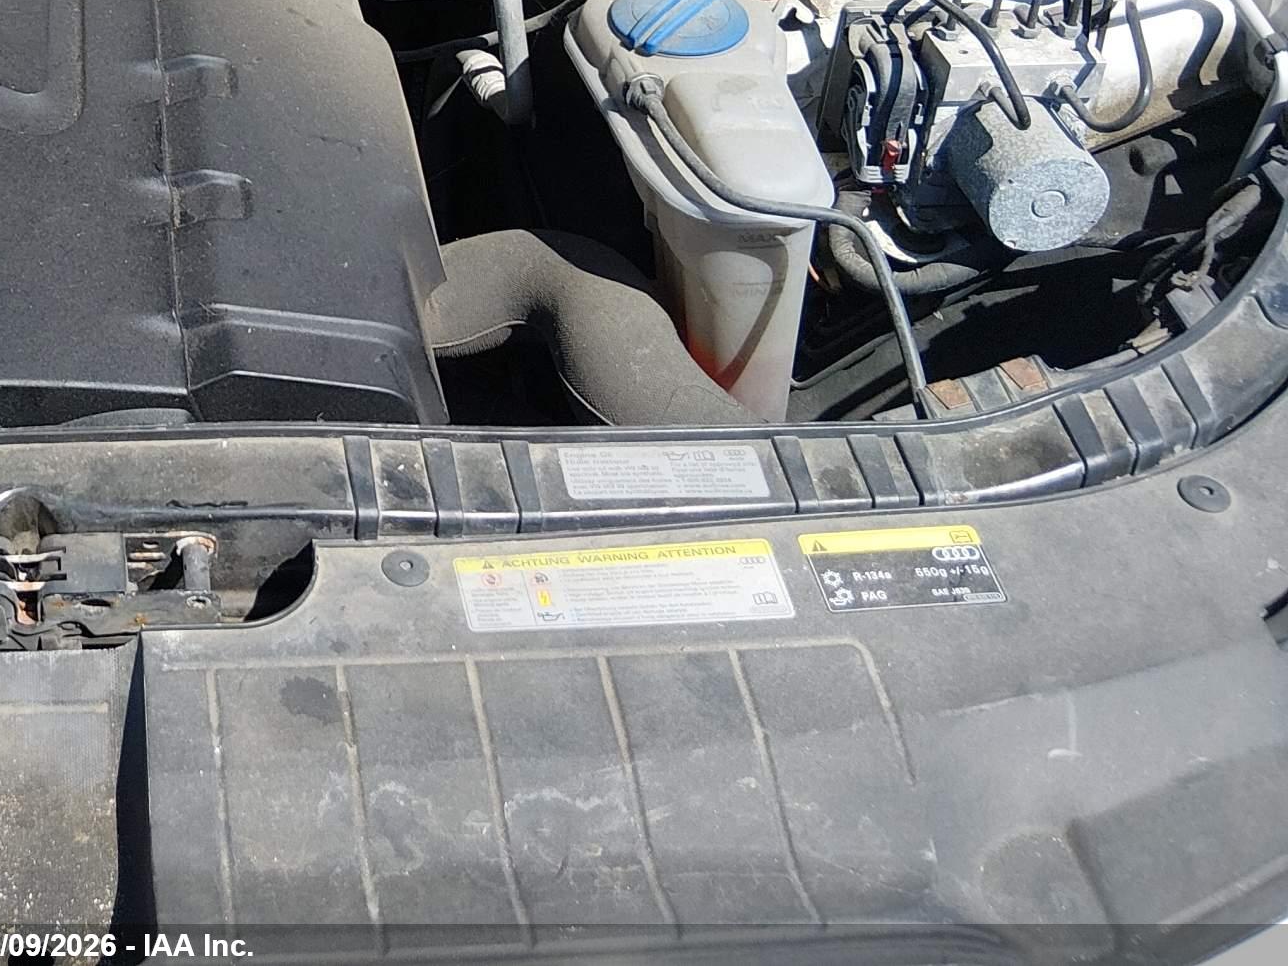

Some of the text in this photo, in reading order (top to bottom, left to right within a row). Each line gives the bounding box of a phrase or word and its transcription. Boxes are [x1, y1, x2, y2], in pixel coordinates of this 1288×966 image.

[502, 546, 737, 568] ACHTUNG WARNING ATTENTION
[852, 571, 892, 582] R-134a
[860, 590, 888, 601] PAG
